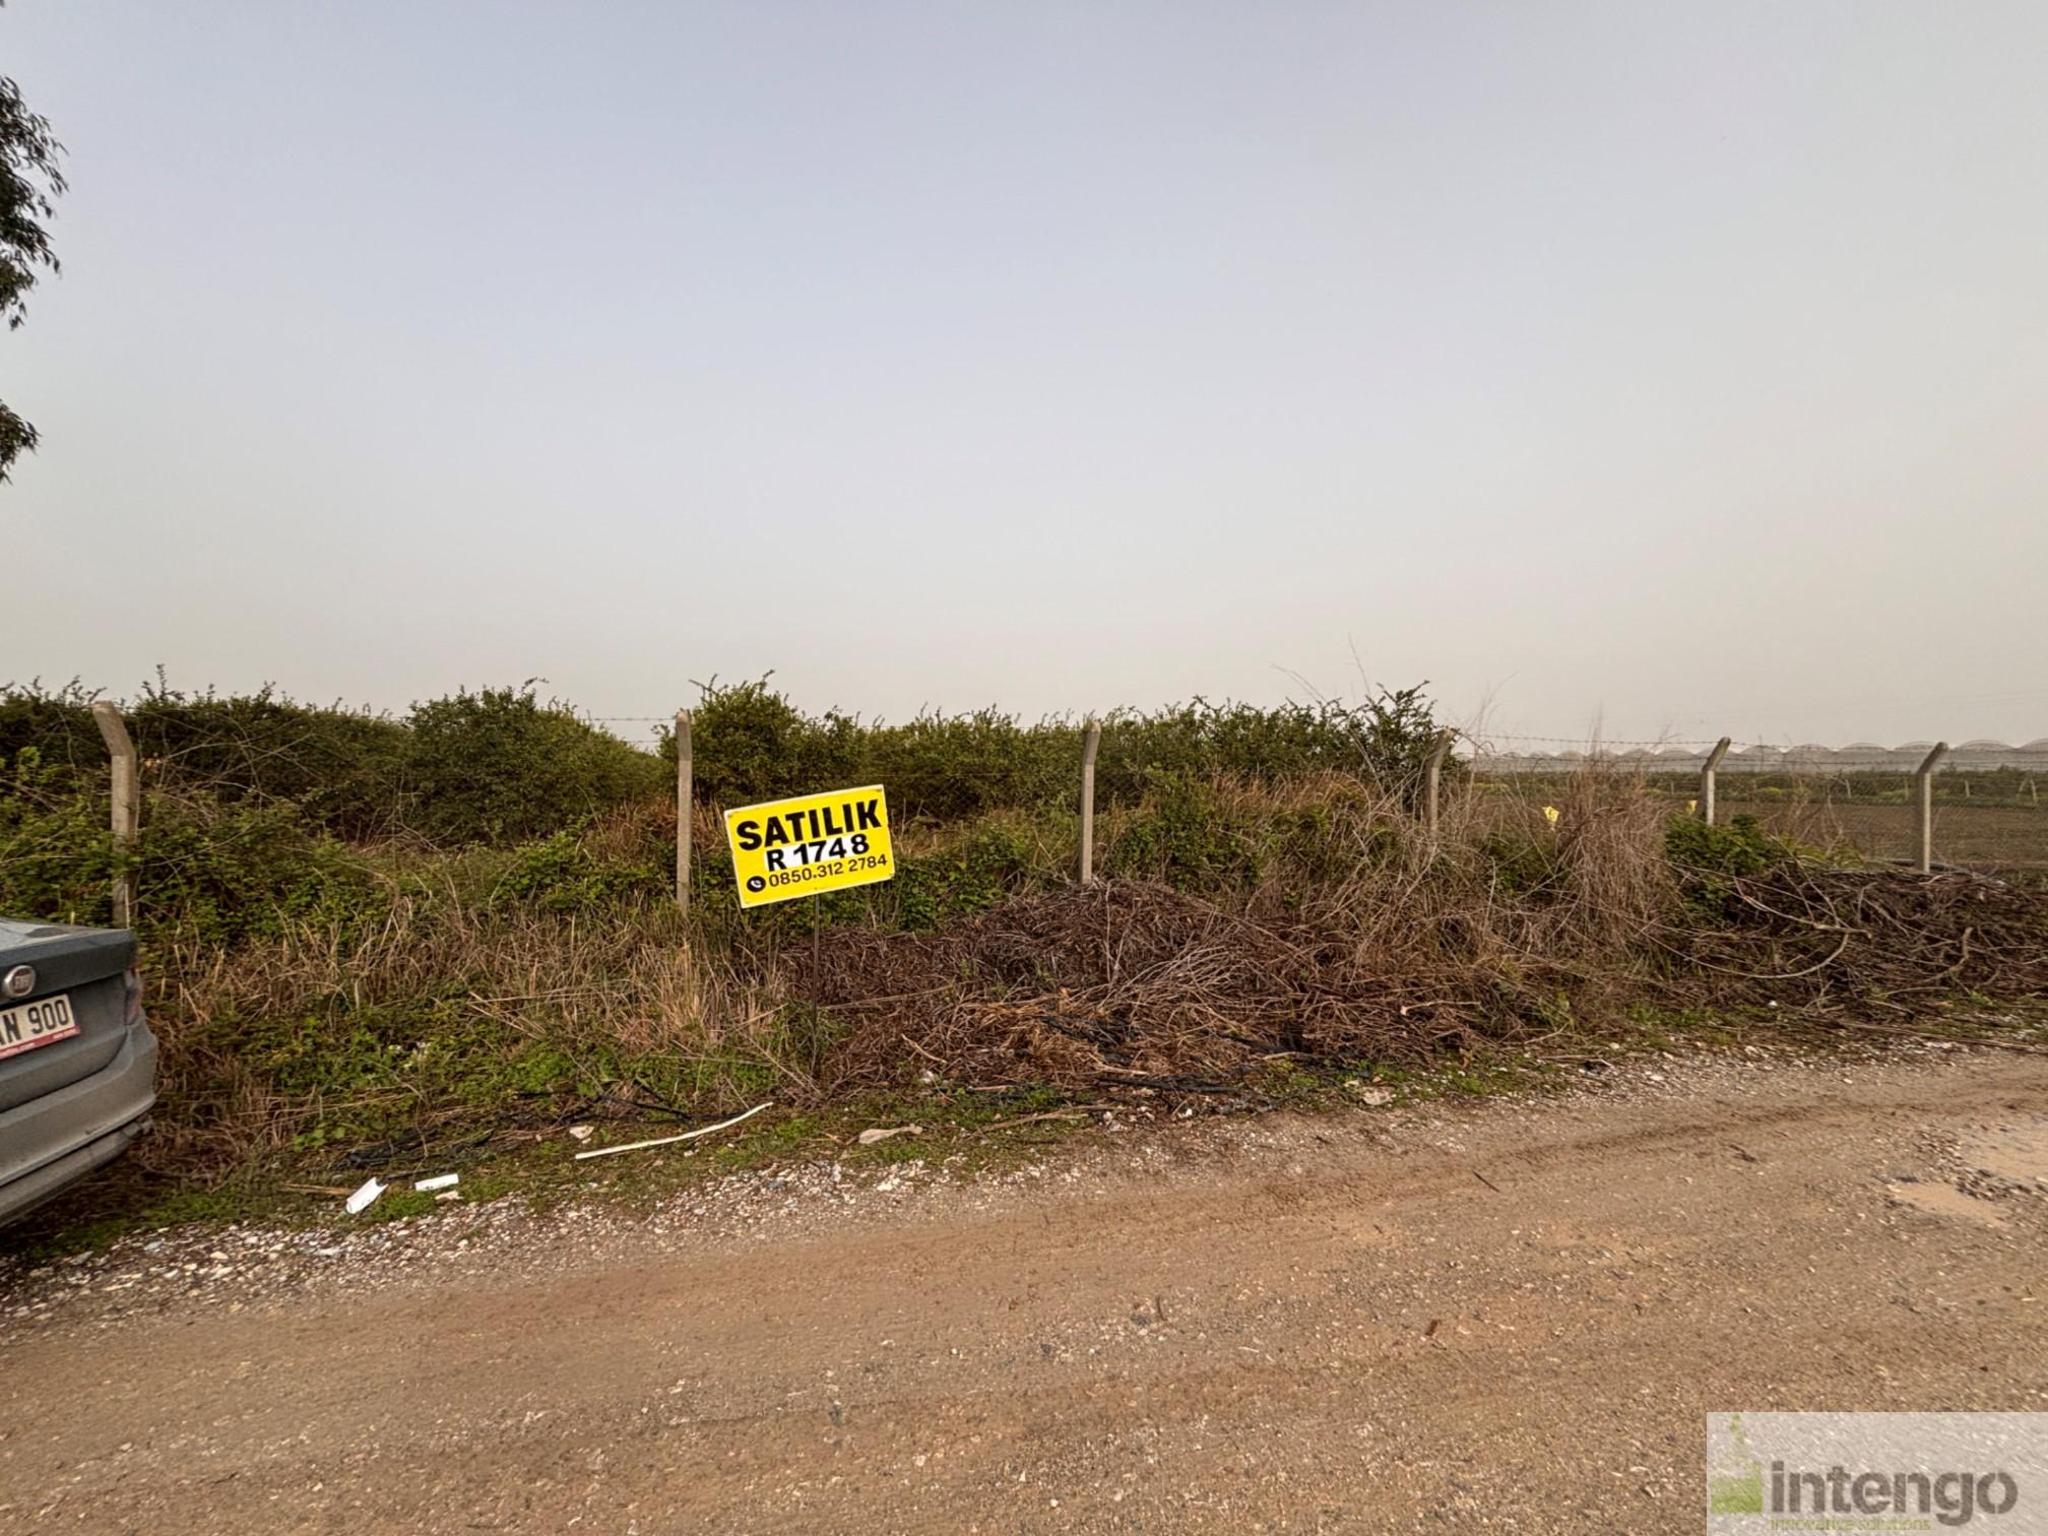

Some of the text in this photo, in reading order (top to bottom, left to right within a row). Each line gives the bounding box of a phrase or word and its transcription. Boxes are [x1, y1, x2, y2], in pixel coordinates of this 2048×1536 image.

[737, 799, 882, 850] SATILIK
[767, 834, 869, 871] R 1748
[769, 854, 887, 887] 0850.312 2784
[28, 1000, 69, 1034] 900
